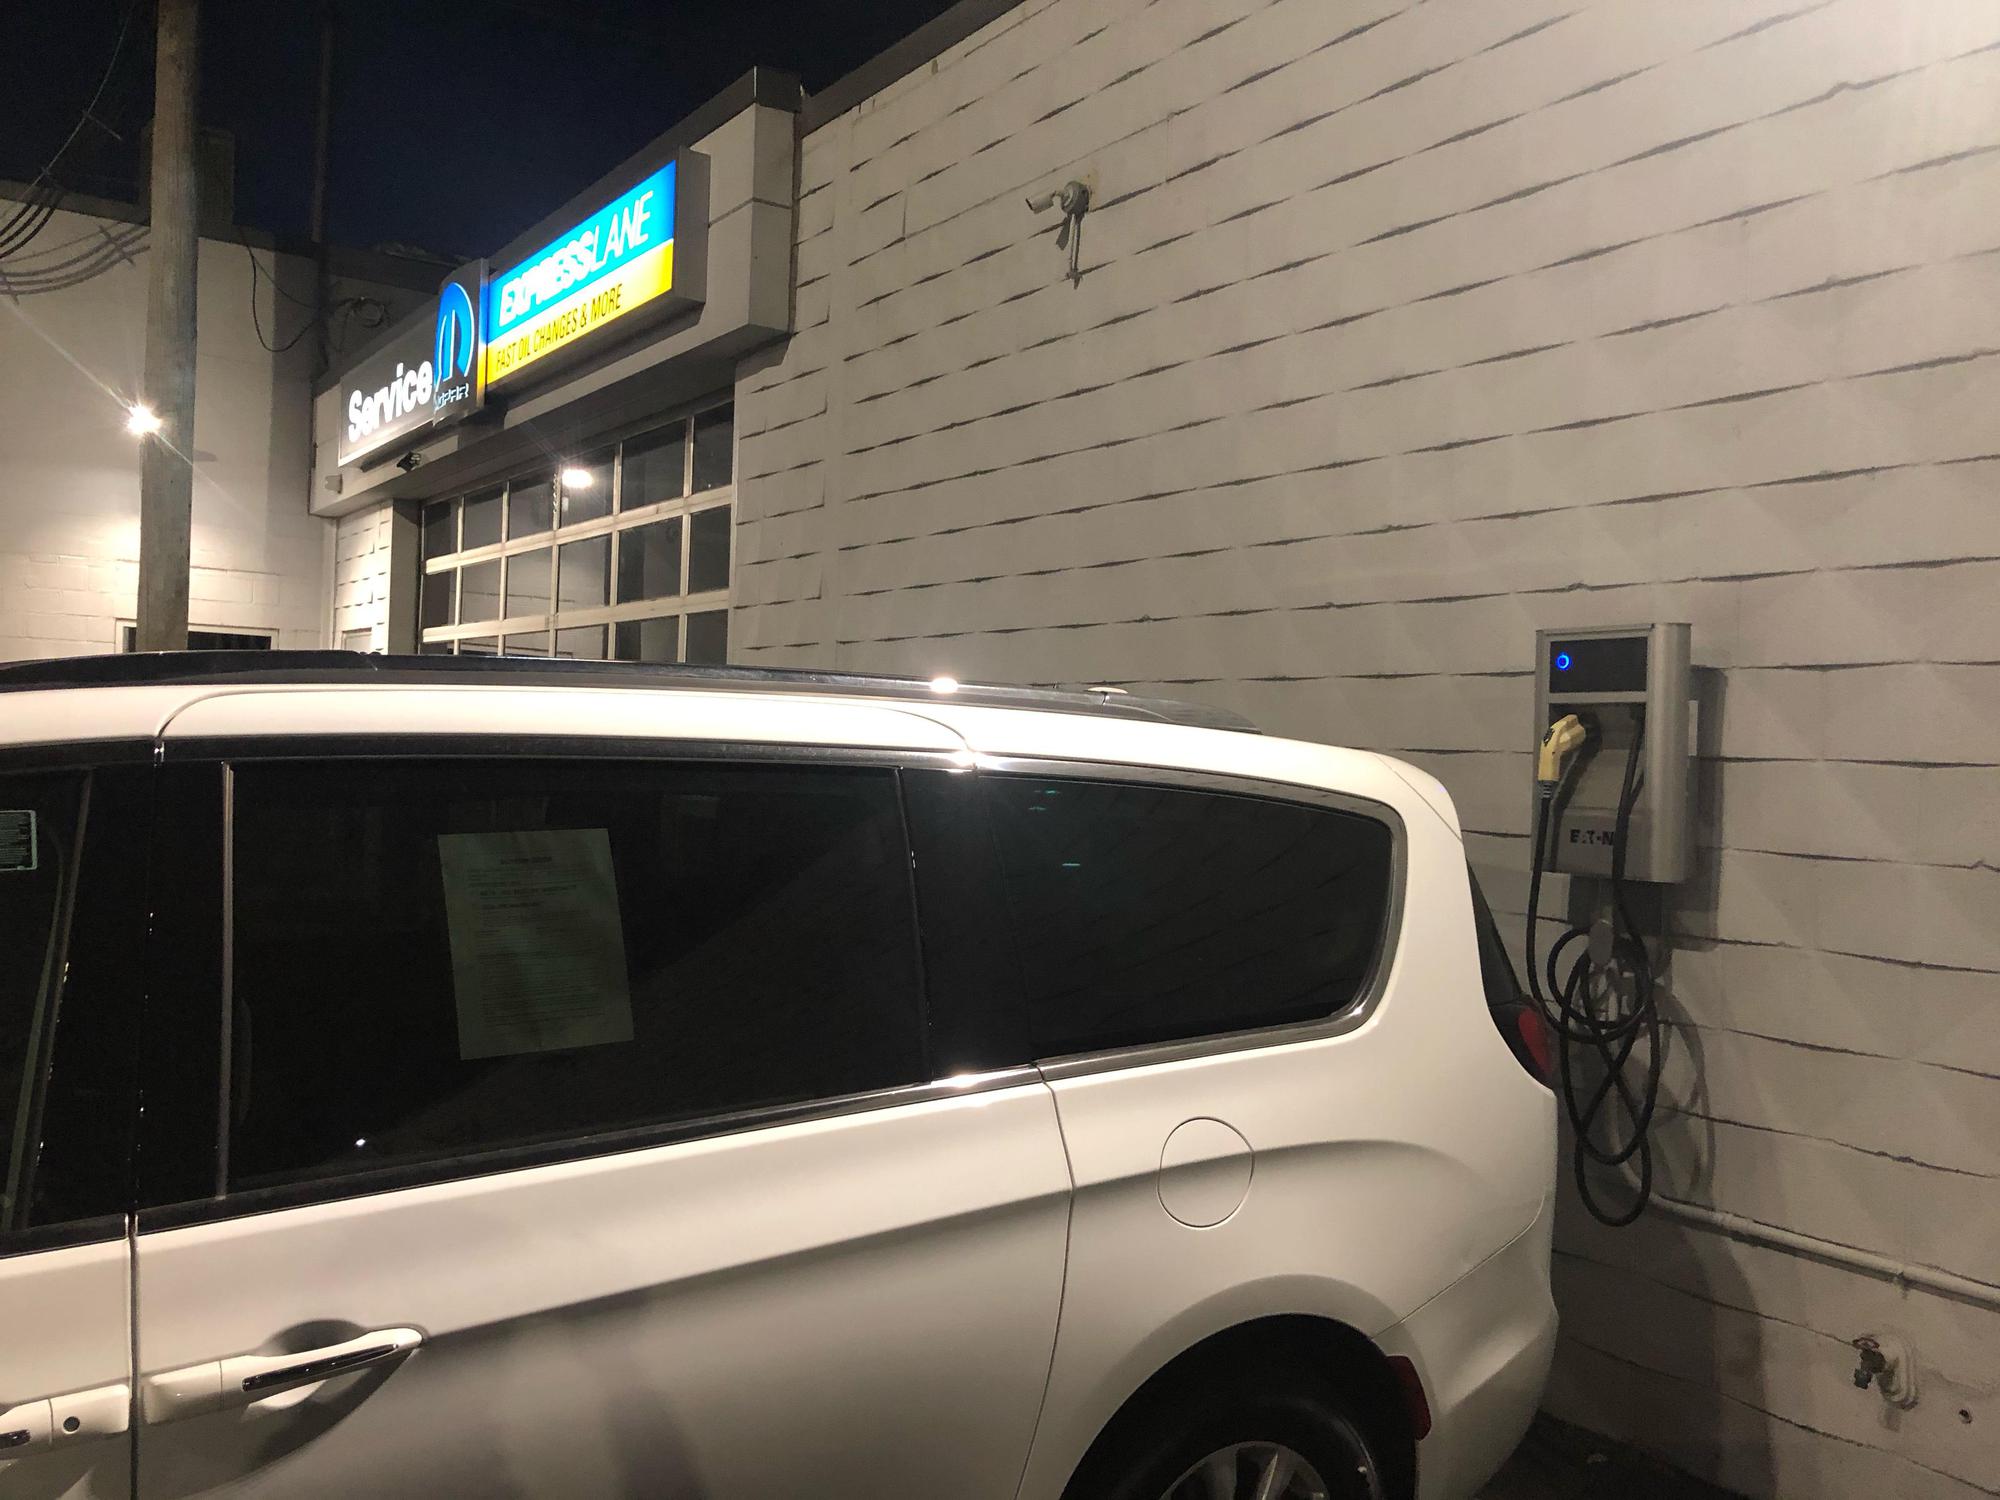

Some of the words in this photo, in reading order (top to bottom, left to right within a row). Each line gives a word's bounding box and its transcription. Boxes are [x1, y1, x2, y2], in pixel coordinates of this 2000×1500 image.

[496, 342, 516, 372] FAST
[518, 334, 531, 361] OIL
[533, 307, 578, 353] CHANGES
[580, 303, 588, 328] &
[591, 283, 622, 323] MORE
[348, 361, 433, 442] Service
